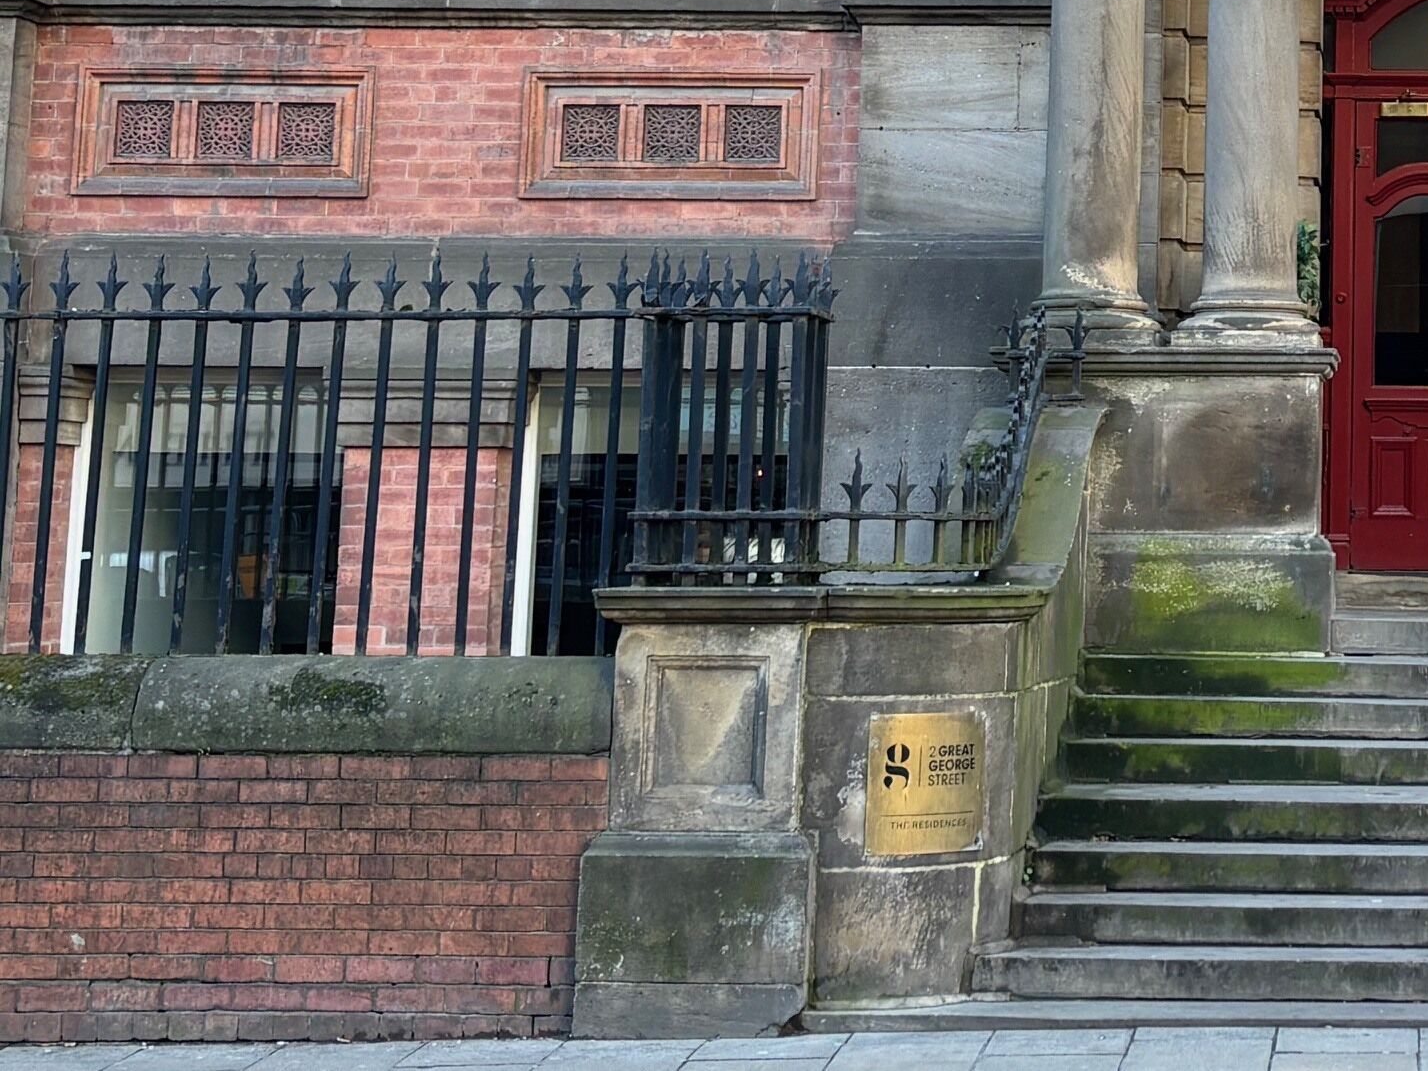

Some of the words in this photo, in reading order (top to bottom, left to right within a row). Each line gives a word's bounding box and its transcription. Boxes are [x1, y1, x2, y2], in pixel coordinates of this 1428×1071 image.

[929, 746, 936, 758] 2
[938, 744, 975, 757] GREAT
[928, 757, 976, 772] GEORGE
[928, 772, 967, 787] STREET
[890, 821, 909, 829] THE
[912, 818, 967, 829] RESIDENCES
